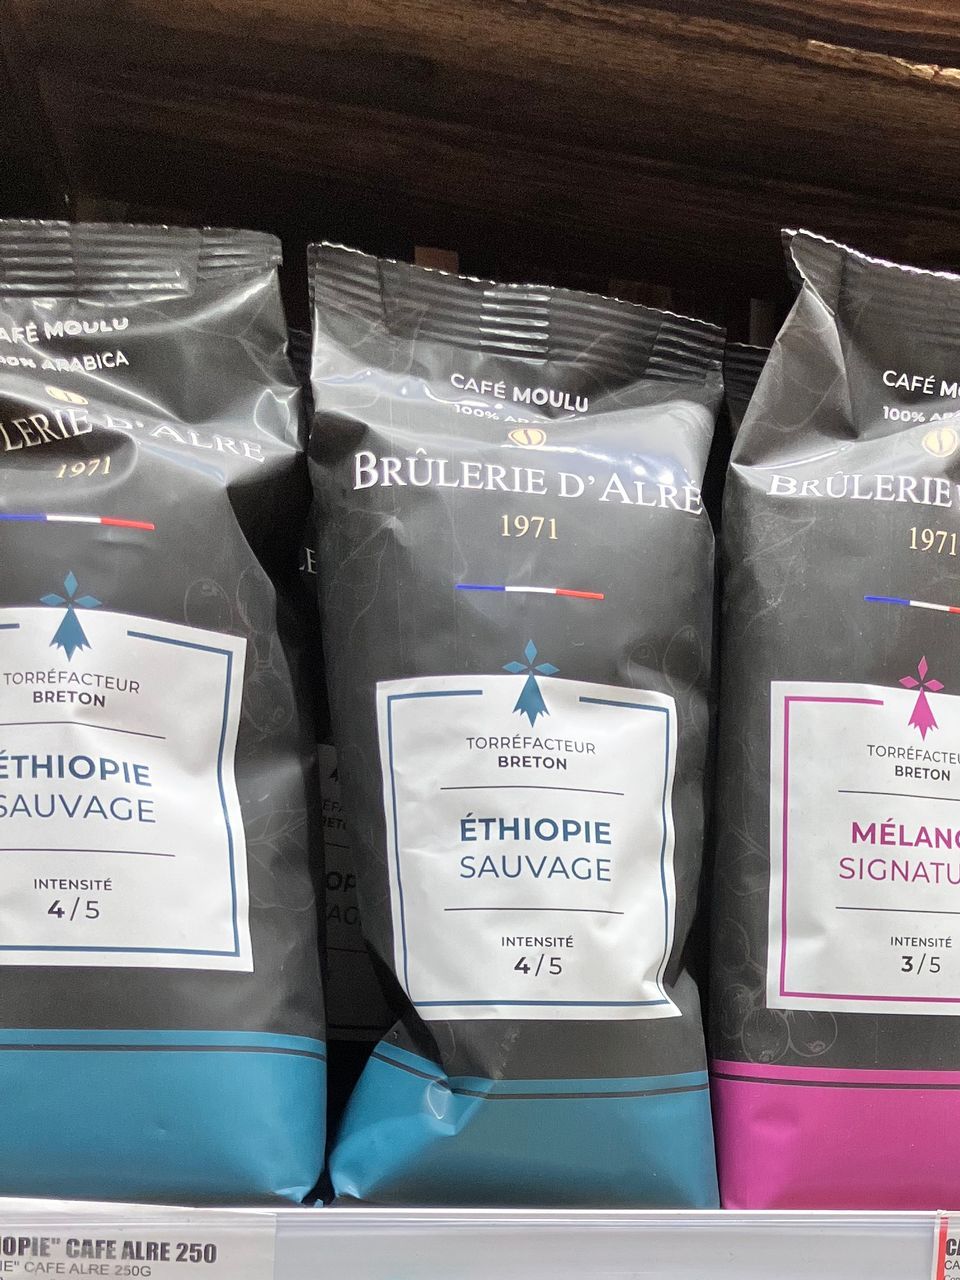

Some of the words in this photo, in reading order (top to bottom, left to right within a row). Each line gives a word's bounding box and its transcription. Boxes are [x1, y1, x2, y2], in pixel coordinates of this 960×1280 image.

[44, 317, 129, 339] MOULU
[42, 350, 130, 372] ARABICA
[450, 373, 506, 399] CAFÉ
[513, 386, 588, 412] MOULU
[882, 370, 935, 395] CAFÉ
[454, 404, 500, 421] 100%
[882, 405, 925, 422] 100%
[56, 456, 111, 479] 1971
[353, 448, 548, 496] BRÛLERIE
[559, 472, 703, 515] D'ALRÉ
[766, 470, 953, 508] BRÛLERIE
[500, 514, 558, 540] 1971
[909, 527, 958, 555] 1971
[3, 669, 140, 694] TORRÉFACTEUR
[33, 690, 105, 707] BRETON
[466, 733, 596, 755] TORRÉFACTEUR
[498, 755, 567, 770] BRETON
[894, 765, 951, 782] BRETON
[460, 811, 612, 845] ÉTHIOPIE
[460, 855, 612, 882] SAUVAGE
[33, 878, 112, 891] INTENSITÉ
[501, 934, 574, 948] INTENSITÉ
[890, 936, 952, 948] INTENSITÉ
[65, 1238, 117, 1260] CAFE
[121, 1241, 171, 1262] ALRE
[175, 1242, 217, 1264] 250
[24, 1261, 66, 1275] CAFE
[69, 1263, 110, 1276] ALRE
[115, 1264, 152, 1278] 250G
